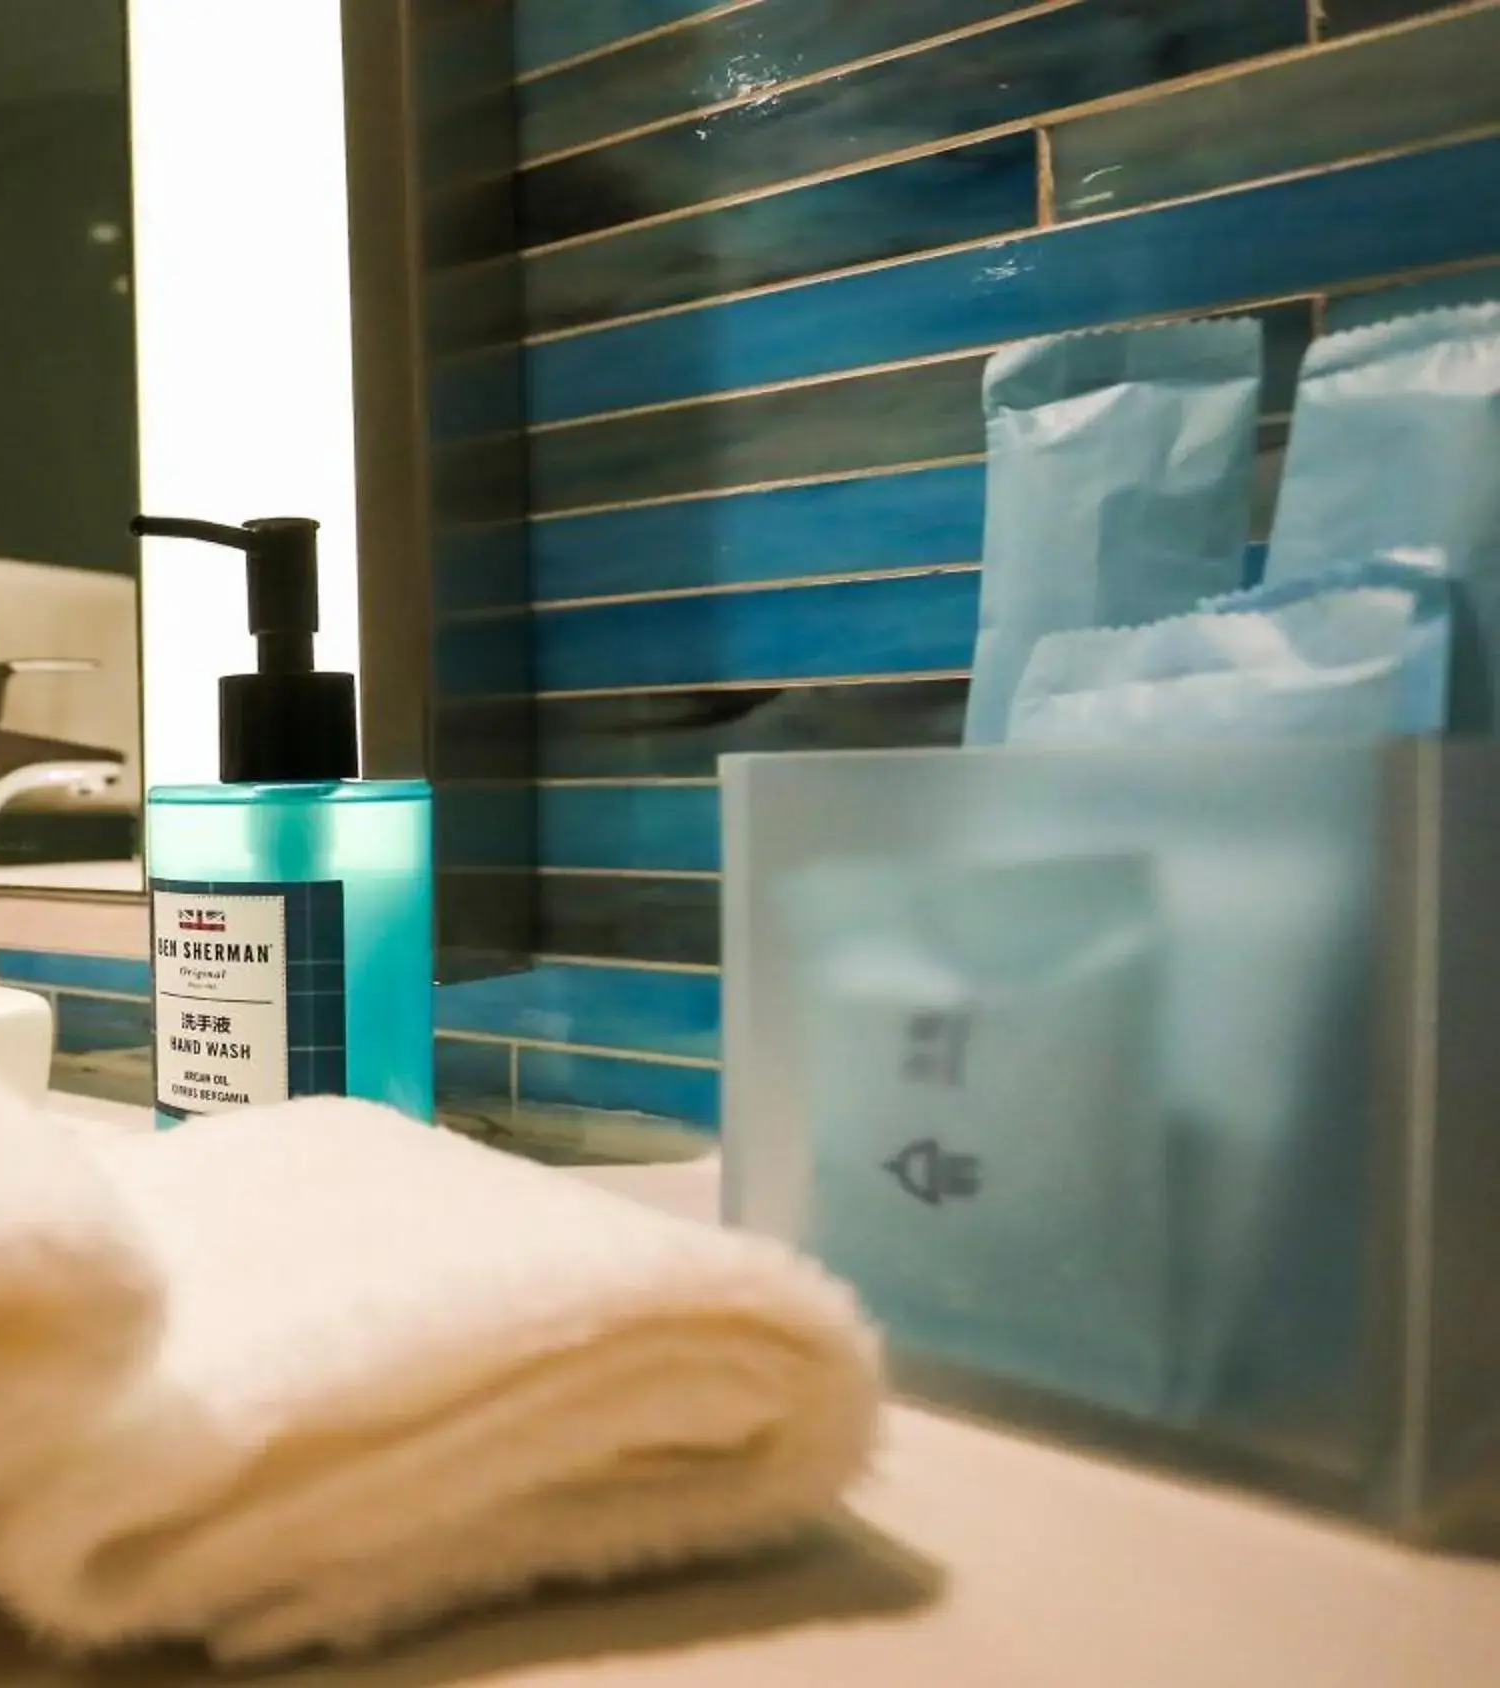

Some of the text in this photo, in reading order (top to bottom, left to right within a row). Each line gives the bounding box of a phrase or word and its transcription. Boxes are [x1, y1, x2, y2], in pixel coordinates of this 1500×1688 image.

[183, 941, 269, 963] SHERMAN
[181, 1012, 231, 1034] 洗手液
[170, 1036, 251, 1060] HAND WASH
[213, 1075, 229, 1086] OIL
